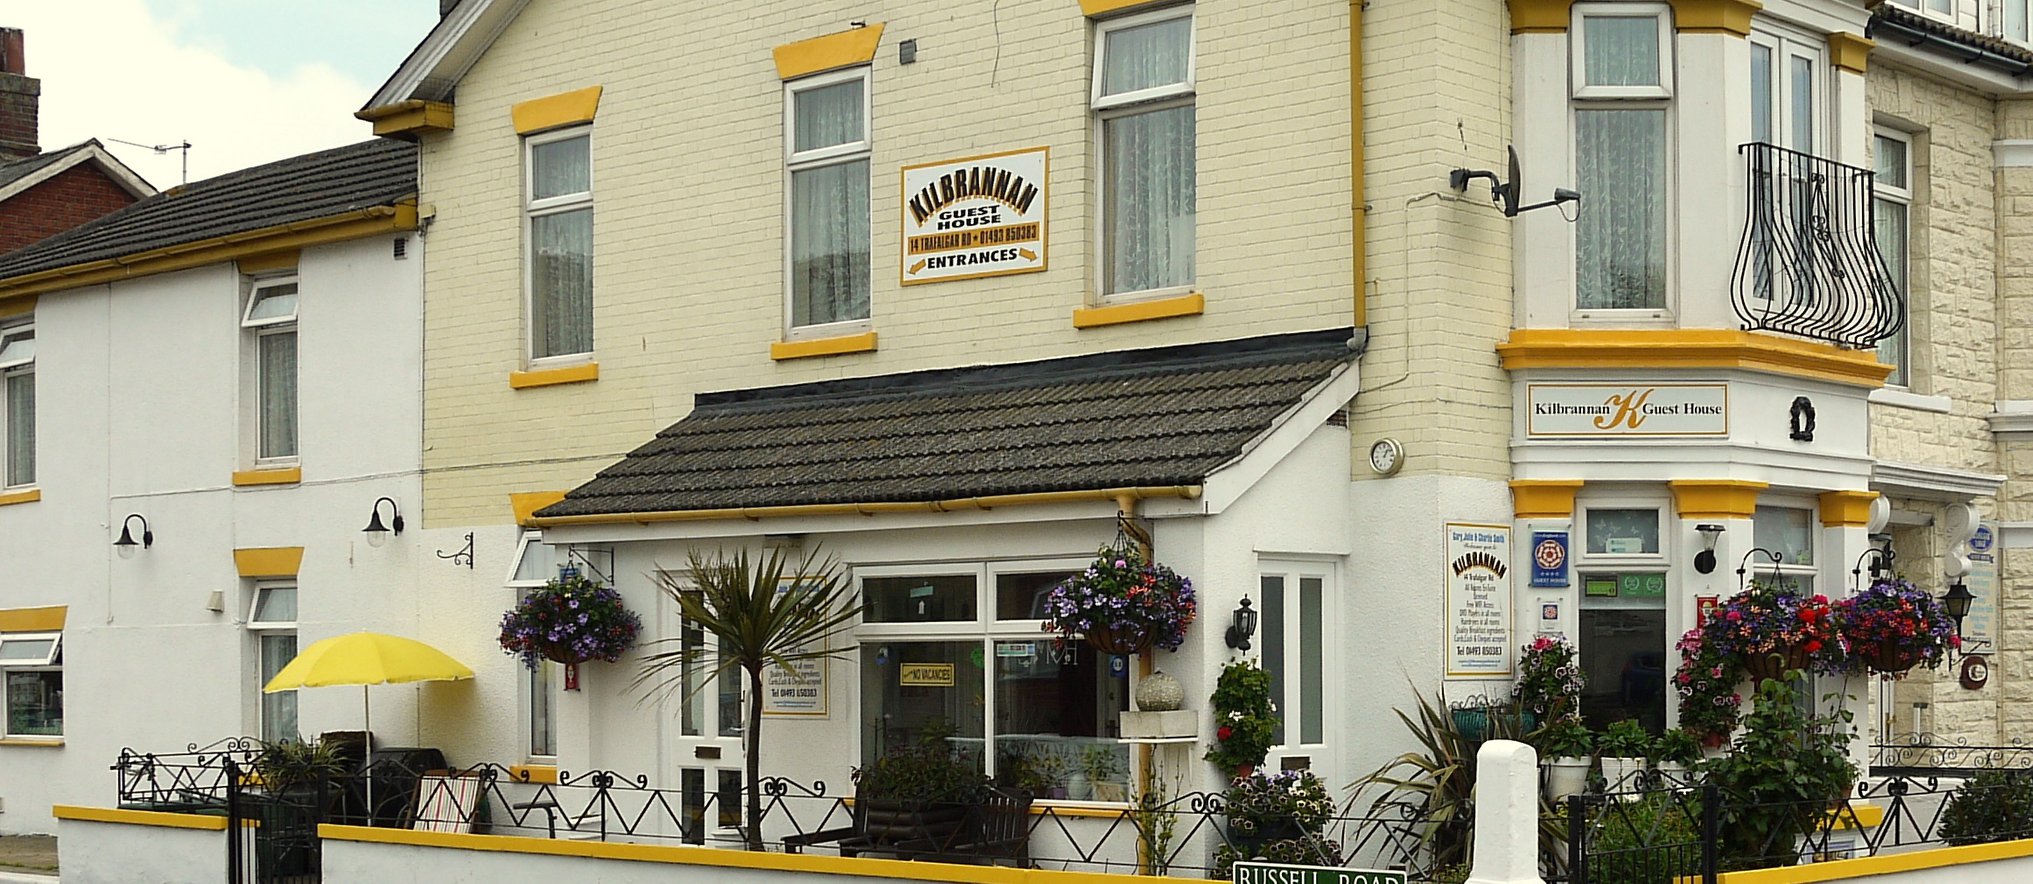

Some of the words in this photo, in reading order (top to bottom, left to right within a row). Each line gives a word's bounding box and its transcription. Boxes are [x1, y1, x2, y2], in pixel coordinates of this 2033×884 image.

[909, 166, 1039, 227] KILBRANNAN
[937, 214, 1001, 231] HOUSE
[939, 204, 1000, 221] GUEST
[910, 239, 919, 252] 14
[921, 233, 960, 252] TRAFALGAR
[961, 232, 972, 247] RD
[980, 228, 1004, 245] 01493
[1005, 224, 1037, 242] 850383
[927, 248, 1018, 269] ENTRANCES
[1535, 403, 1610, 415] Kilbrannan
[1593, 388, 1655, 430] K
[1642, 403, 1679, 415] Guest
[1683, 403, 1722, 415] House
[1452, 551, 1507, 579] KILBRANNAN
[912, 669, 920, 680] NO
[921, 668, 951, 680] VACANCIES
[771, 688, 780, 697] Tel
